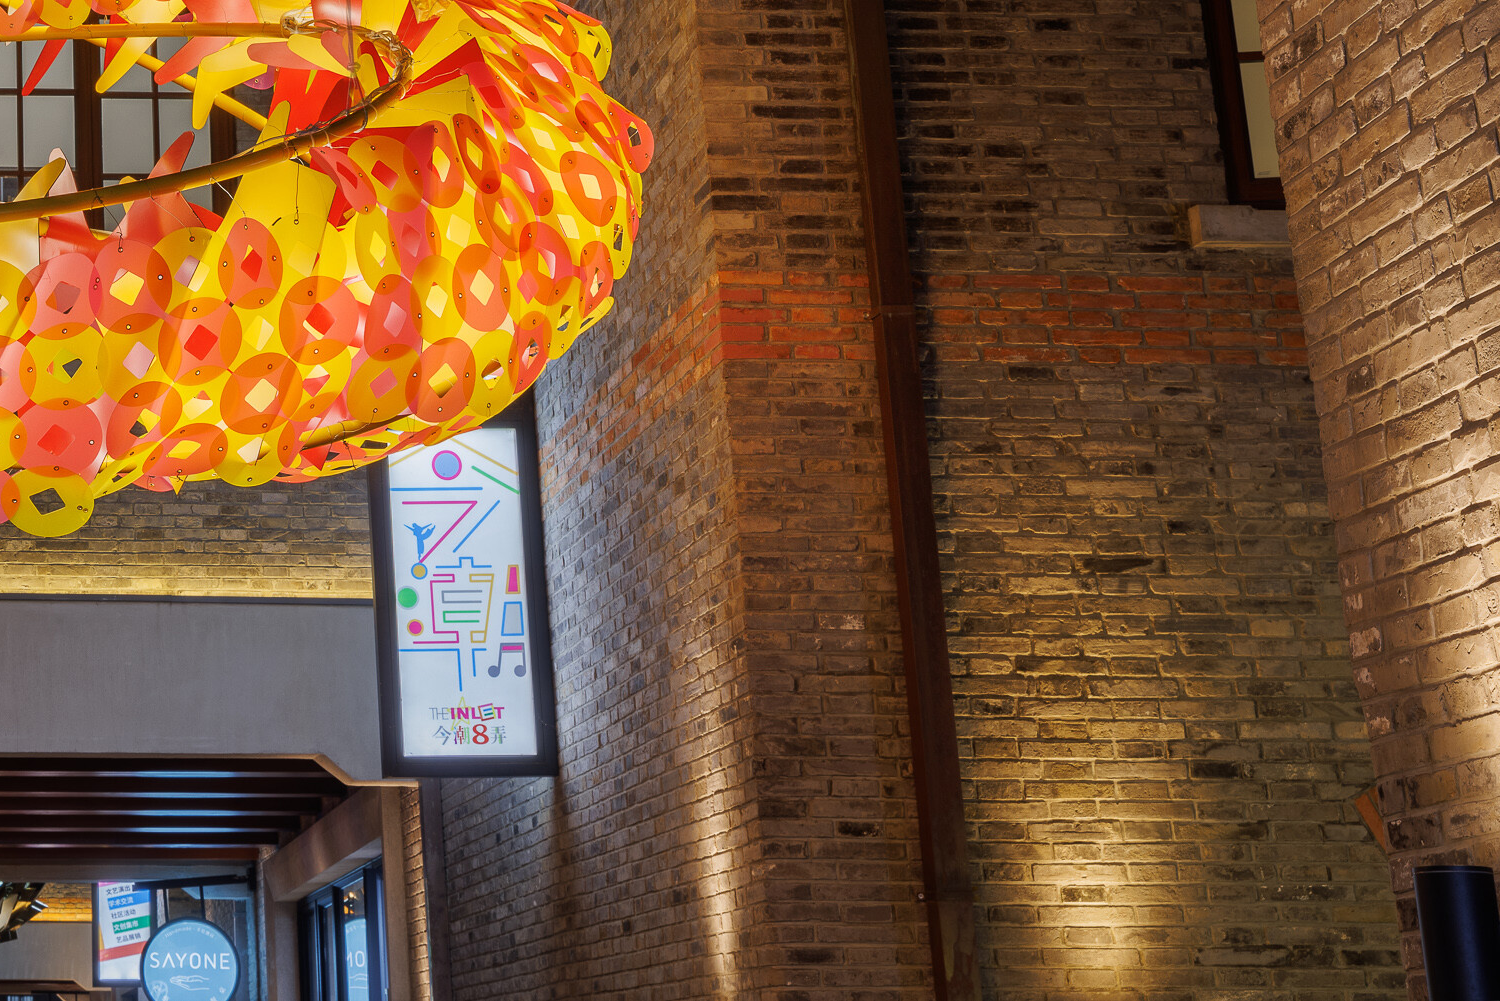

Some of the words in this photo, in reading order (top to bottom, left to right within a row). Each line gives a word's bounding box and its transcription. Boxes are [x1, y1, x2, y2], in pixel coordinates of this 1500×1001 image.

[450, 703, 505, 722] INLET
[432, 723, 507, 746] 今潮8弄
[105, 884, 131, 896] 文艺演出
[108, 895, 134, 908] 学术交流
[110, 908, 137, 919] 社区活动
[113, 920, 139, 932] 文创集市
[149, 952, 231, 970] SAYONE
